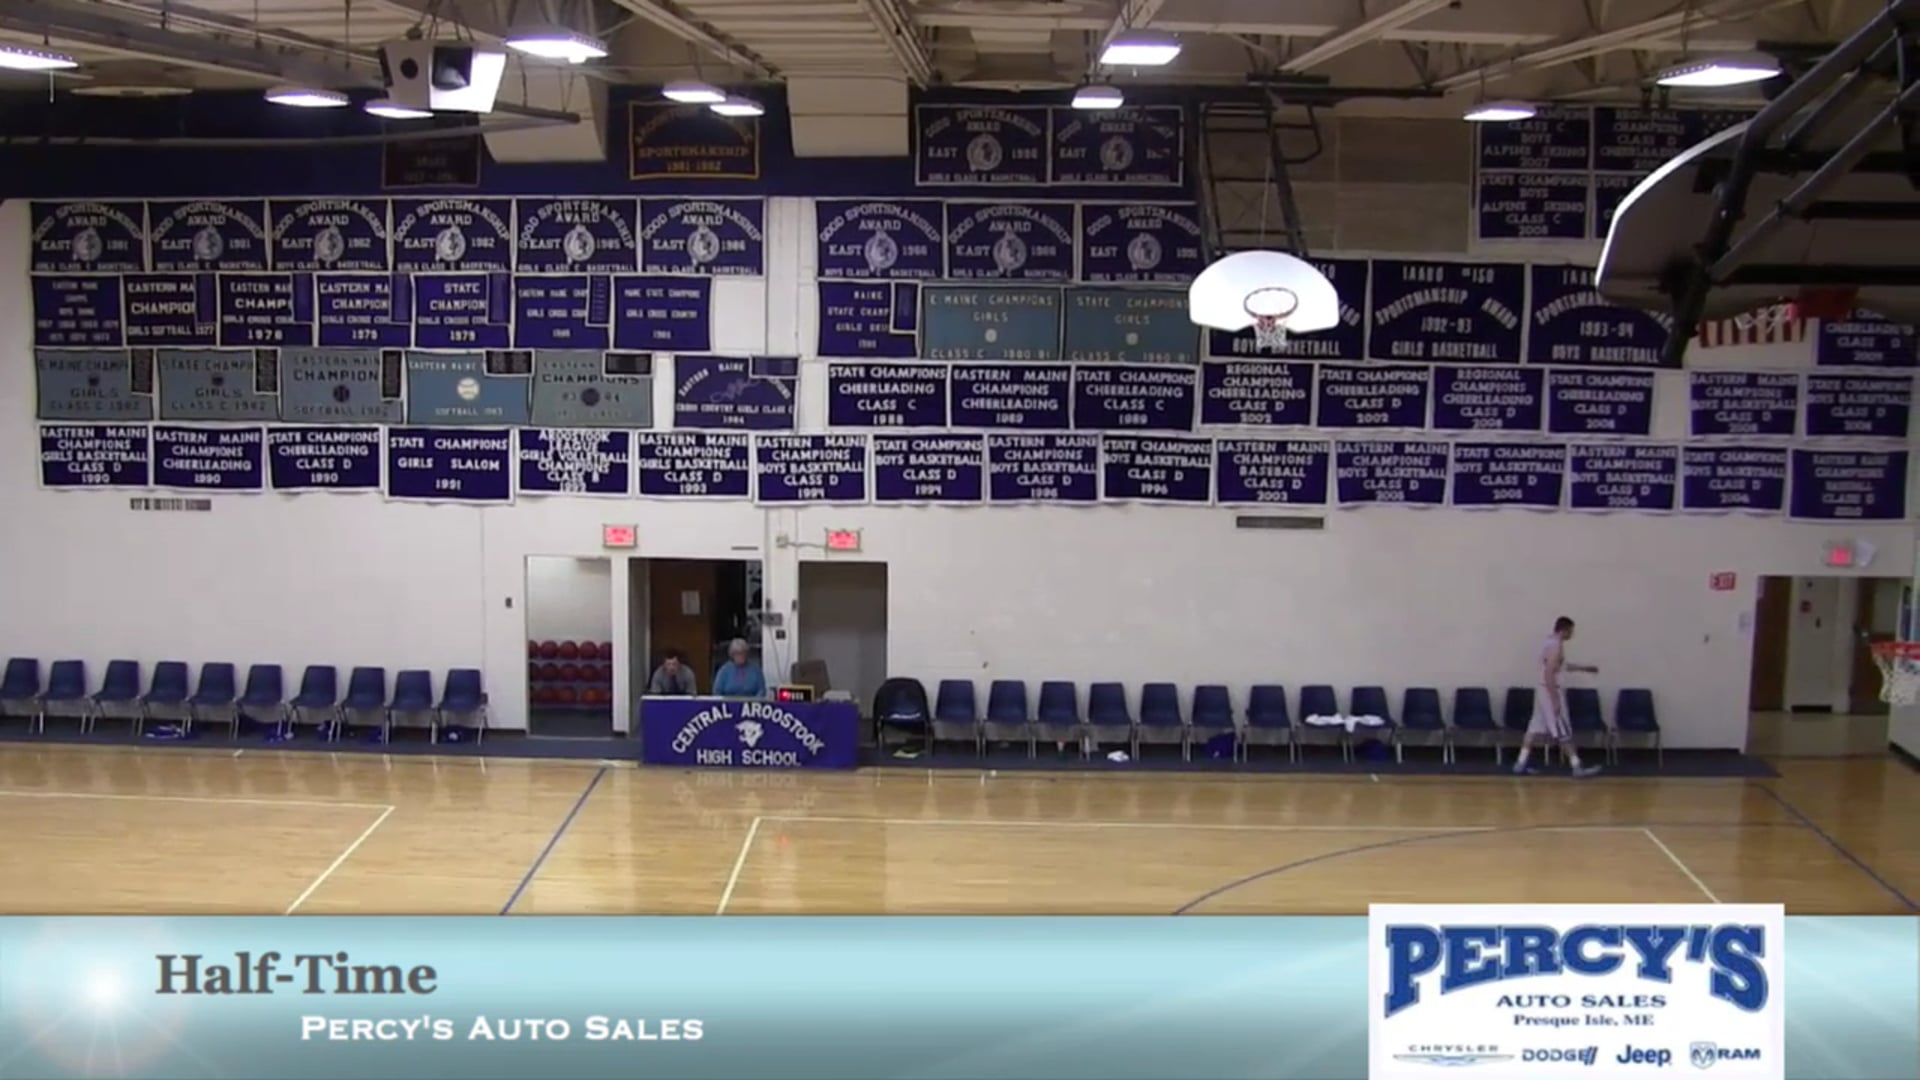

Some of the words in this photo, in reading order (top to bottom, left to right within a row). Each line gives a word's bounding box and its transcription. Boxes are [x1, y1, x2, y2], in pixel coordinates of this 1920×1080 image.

[444, 282, 480, 294] STATE
[830, 367, 865, 379] STATE
[870, 367, 946, 380] CHAMPIONS
[953, 369, 1010, 382] EASTERN
[1024, 370, 1067, 382] MAINE
[1226, 363, 1290, 376] REGIONAL
[1356, 370, 1429, 382] CHAMPIONS
[1075, 370, 1111, 383] STATE
[1120, 371, 1196, 386] CHAMPIONS
[1223, 376, 1293, 388] CHAMPION
[840, 382, 935, 396] CHEERLEADING
[972, 383, 1050, 396] CHAMPIONS
[1086, 384, 1184, 398] CHEERLEADING
[1208, 388, 1305, 401] CHEERLEADING
[1326, 384, 1420, 396] CHEERLEADING
[857, 399, 897, 411] CLASS
[907, 399, 917, 411] C
[961, 397, 1059, 410] CHEERLEADING
[1103, 398, 1145, 410] CLASS
[1156, 399, 1165, 410] C
[1228, 400, 1267, 412] CLASS
[1275, 400, 1284, 412] D
[1344, 398, 1384, 410] CLASS
[1392, 398, 1402, 410] D
[42, 427, 95, 439] EASTERN
[106, 427, 147, 439] MAINE
[155, 431, 207, 443] EASTERN
[219, 431, 260, 443] MAINE
[267, 432, 301, 444] STATE
[307, 431, 379, 444] CHAMPIONS
[57, 439, 131, 451] CHAMPIONS
[390, 436, 424, 449] STATE
[434, 437, 507, 451] CHAMPIONS
[640, 434, 696, 446] EASTERN
[705, 435, 748, 447] MAINE
[756, 436, 812, 448] EASTERN
[824, 435, 866, 448] MAINE
[874, 439, 907, 452] STATE
[912, 439, 983, 452] CHAMPIONS
[989, 436, 1045, 449] EASTERN
[1103, 438, 1137, 451] STATE
[1140, 440, 1212, 455] CHAMPIONS
[1218, 440, 1277, 453] EASTERN
[42, 451, 73, 462] GIRLS
[77, 451, 147, 462] BASKETBALL
[172, 445, 244, 458] CHAMPIONS
[278, 444, 369, 457] CHEERLEADING
[655, 446, 731, 459] CHAMPIONS
[772, 448, 850, 461] CHAMPIONS
[1004, 449, 1083, 462] CHAMPIONS
[163, 458, 252, 471] CHEERLEADING
[296, 458, 334, 470] CLASS
[343, 459, 352, 470] D
[398, 457, 433, 469] GIRLS
[450, 458, 500, 472] SLALOM
[640, 458, 670, 470] GIRLS
[675, 459, 748, 471] BASKETBALL
[876, 453, 904, 466] BOYS
[909, 453, 982, 467] BASKETBALL
[1104, 452, 1131, 464] BOYS
[1135, 454, 1211, 469] BASKETBALL
[1233, 454, 1313, 467] CHAMPIONS
[1352, 454, 1431, 467] CHAMPIONS
[67, 462, 104, 474] CLASS
[113, 463, 121, 474] D
[757, 462, 786, 474] BOYS
[789, 461, 864, 474] BASKETBALL
[1239, 466, 1306, 479] BASEBALL
[664, 471, 703, 483] CLASS
[713, 471, 722, 483] D
[783, 474, 822, 487] CLASS
[829, 474, 838, 486] D
[903, 468, 940, 481] CLASS
[947, 469, 956, 481] D
[1127, 468, 1167, 481] CLASS
[1175, 469, 1184, 482] D
[1244, 478, 1283, 491] CLASS
[1292, 478, 1301, 491] D
[672, 702, 733, 753] CENTRAL
[742, 702, 824, 755] AROOSTOOK
[697, 749, 732, 765] HIGH
[742, 750, 800, 766] SCHOOL
